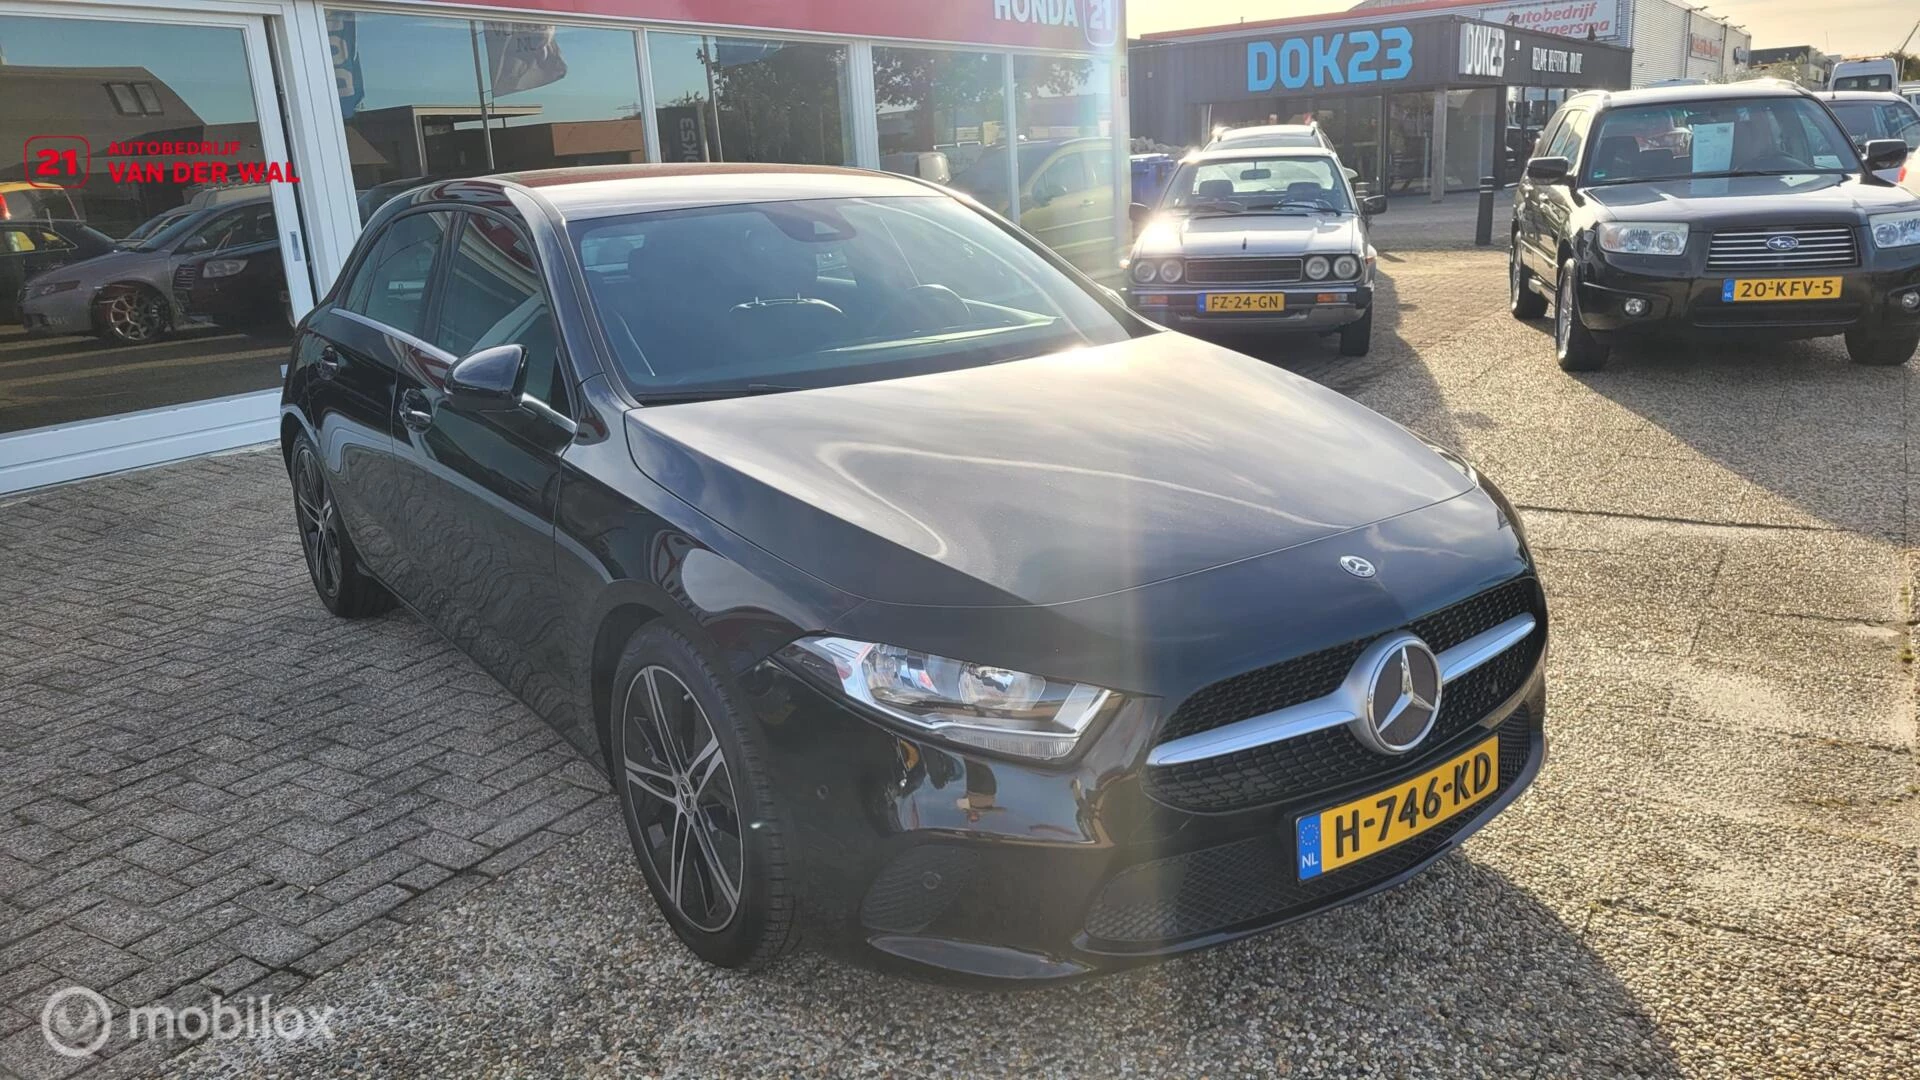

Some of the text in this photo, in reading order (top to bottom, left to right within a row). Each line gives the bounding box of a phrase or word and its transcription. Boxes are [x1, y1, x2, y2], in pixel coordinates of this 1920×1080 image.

[994, 0, 1079, 27] HONDA
[1247, 26, 1413, 91] DOK23
[1463, 23, 1506, 77] DOK23
[1211, 295, 1278, 309] FZ-24-GN
[1741, 280, 1833, 298] 20-KFV-5
[1302, 752, 1492, 869] NL H-746-KD
